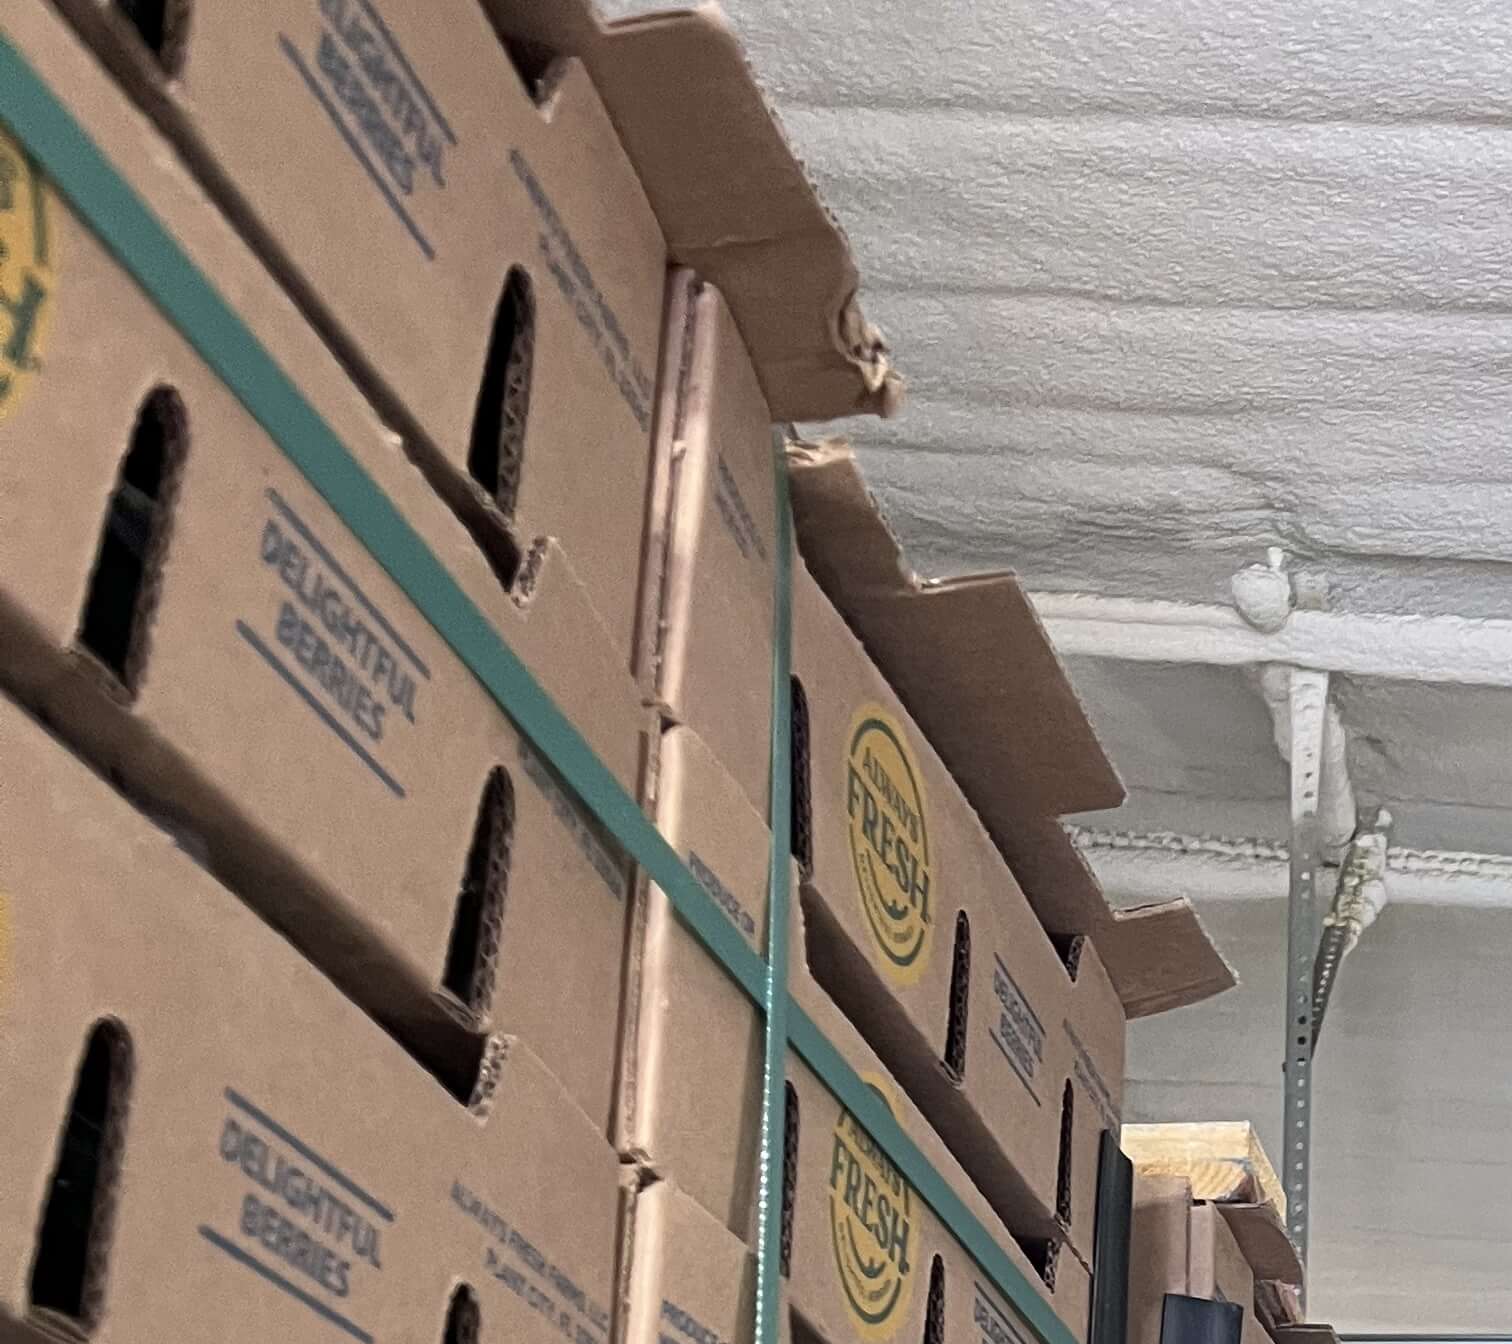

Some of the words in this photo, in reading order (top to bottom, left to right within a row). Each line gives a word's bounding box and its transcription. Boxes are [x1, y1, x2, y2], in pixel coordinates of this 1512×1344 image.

[848, 757, 929, 924] FRESH
[219, 1117, 383, 1271] DELIGHTFUL
[830, 1135, 910, 1276] FRESH
